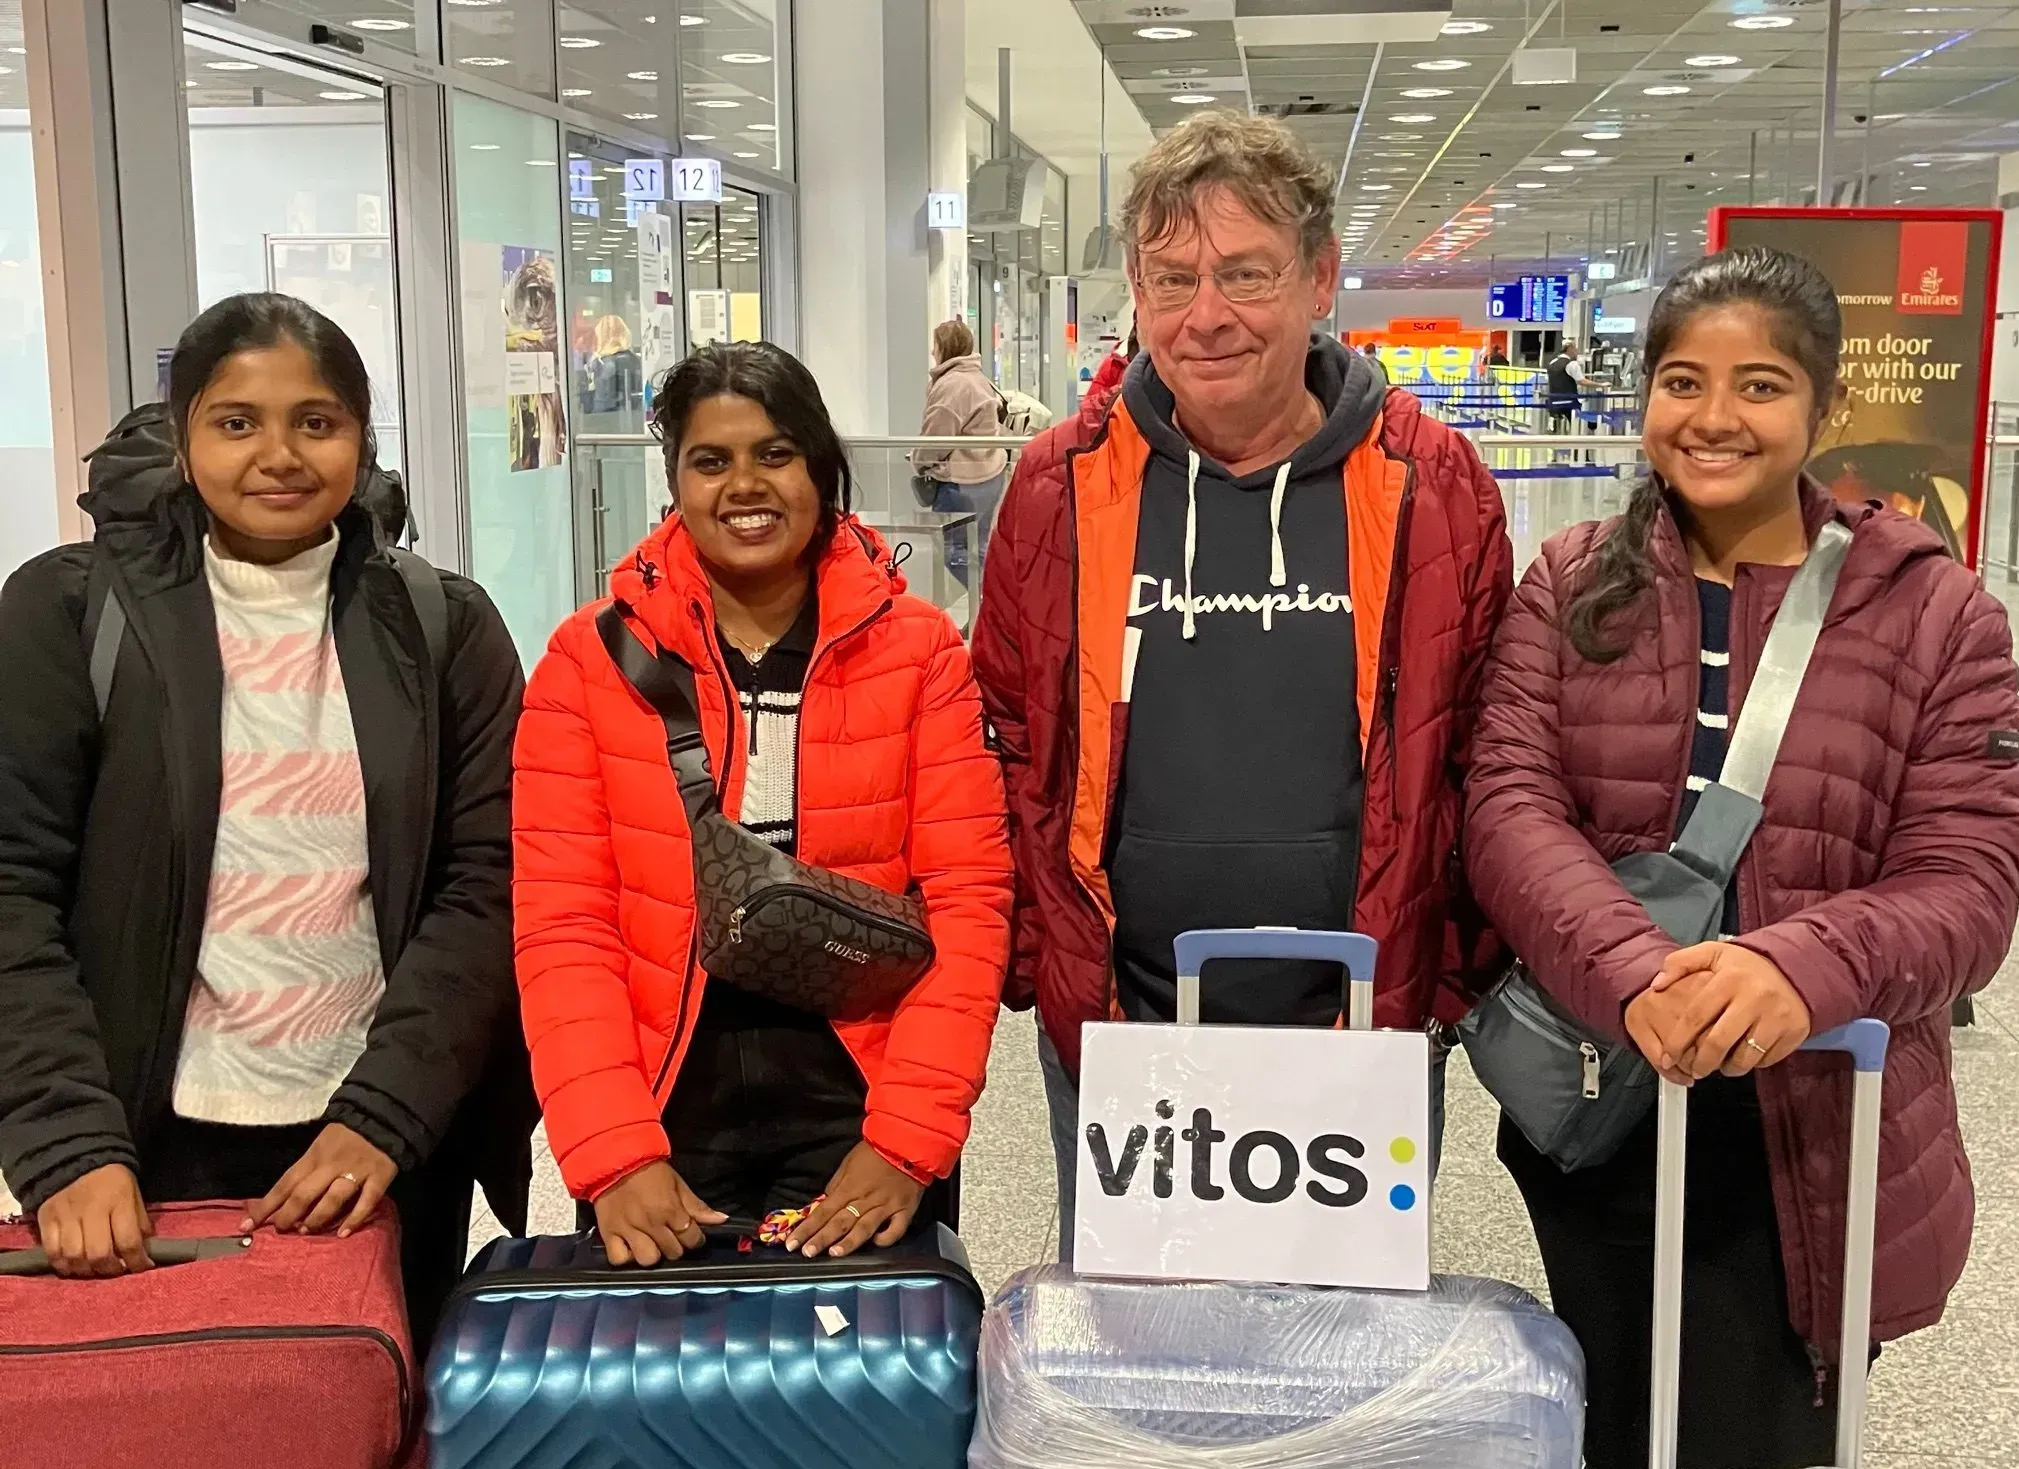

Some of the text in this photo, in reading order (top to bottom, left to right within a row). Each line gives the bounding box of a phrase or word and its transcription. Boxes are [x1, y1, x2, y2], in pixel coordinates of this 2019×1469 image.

[679, 168, 705, 191] 12
[935, 200, 954, 220] 11
[1492, 299, 1504, 317] D
[1836, 294, 1893, 306] omorrow
[1901, 292, 1959, 306] Emirates
[1839, 333, 1933, 356] om door
[1836, 357, 1962, 381] or with our
[1847, 381, 1924, 404] r-drive
[824, 940, 871, 965] GUESS
